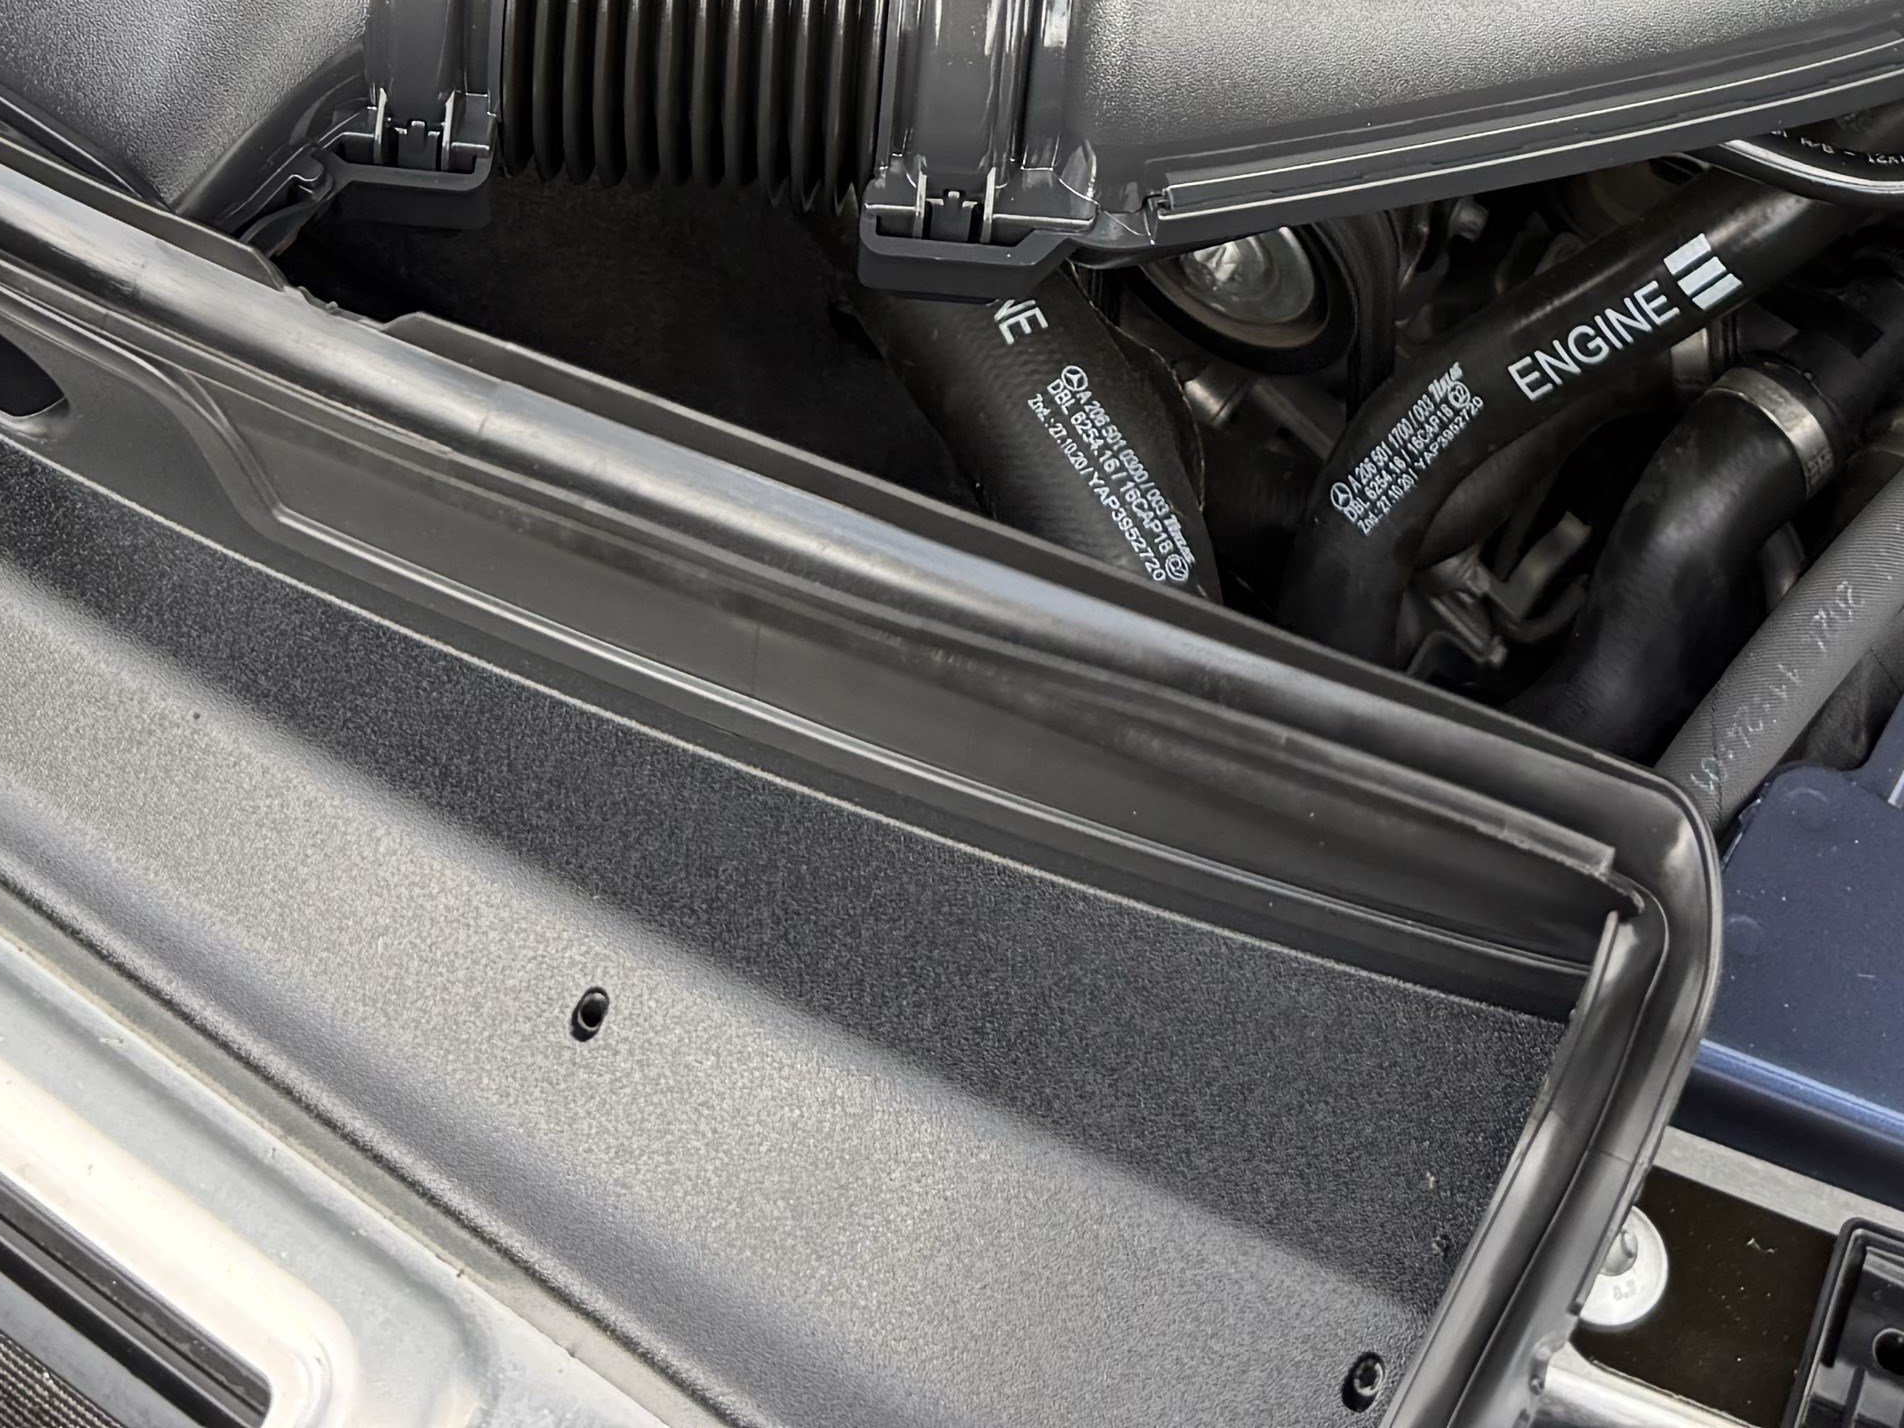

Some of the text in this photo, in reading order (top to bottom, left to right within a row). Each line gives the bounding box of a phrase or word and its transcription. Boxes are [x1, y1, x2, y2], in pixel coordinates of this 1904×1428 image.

[1507, 280, 1681, 402] ENGINE
[1047, 378, 1076, 416] DBL
[1076, 390, 1092, 405] A
[1084, 400, 1111, 428] 206
[1347, 474, 1362, 494] A
[1343, 497, 1371, 524] DBL
